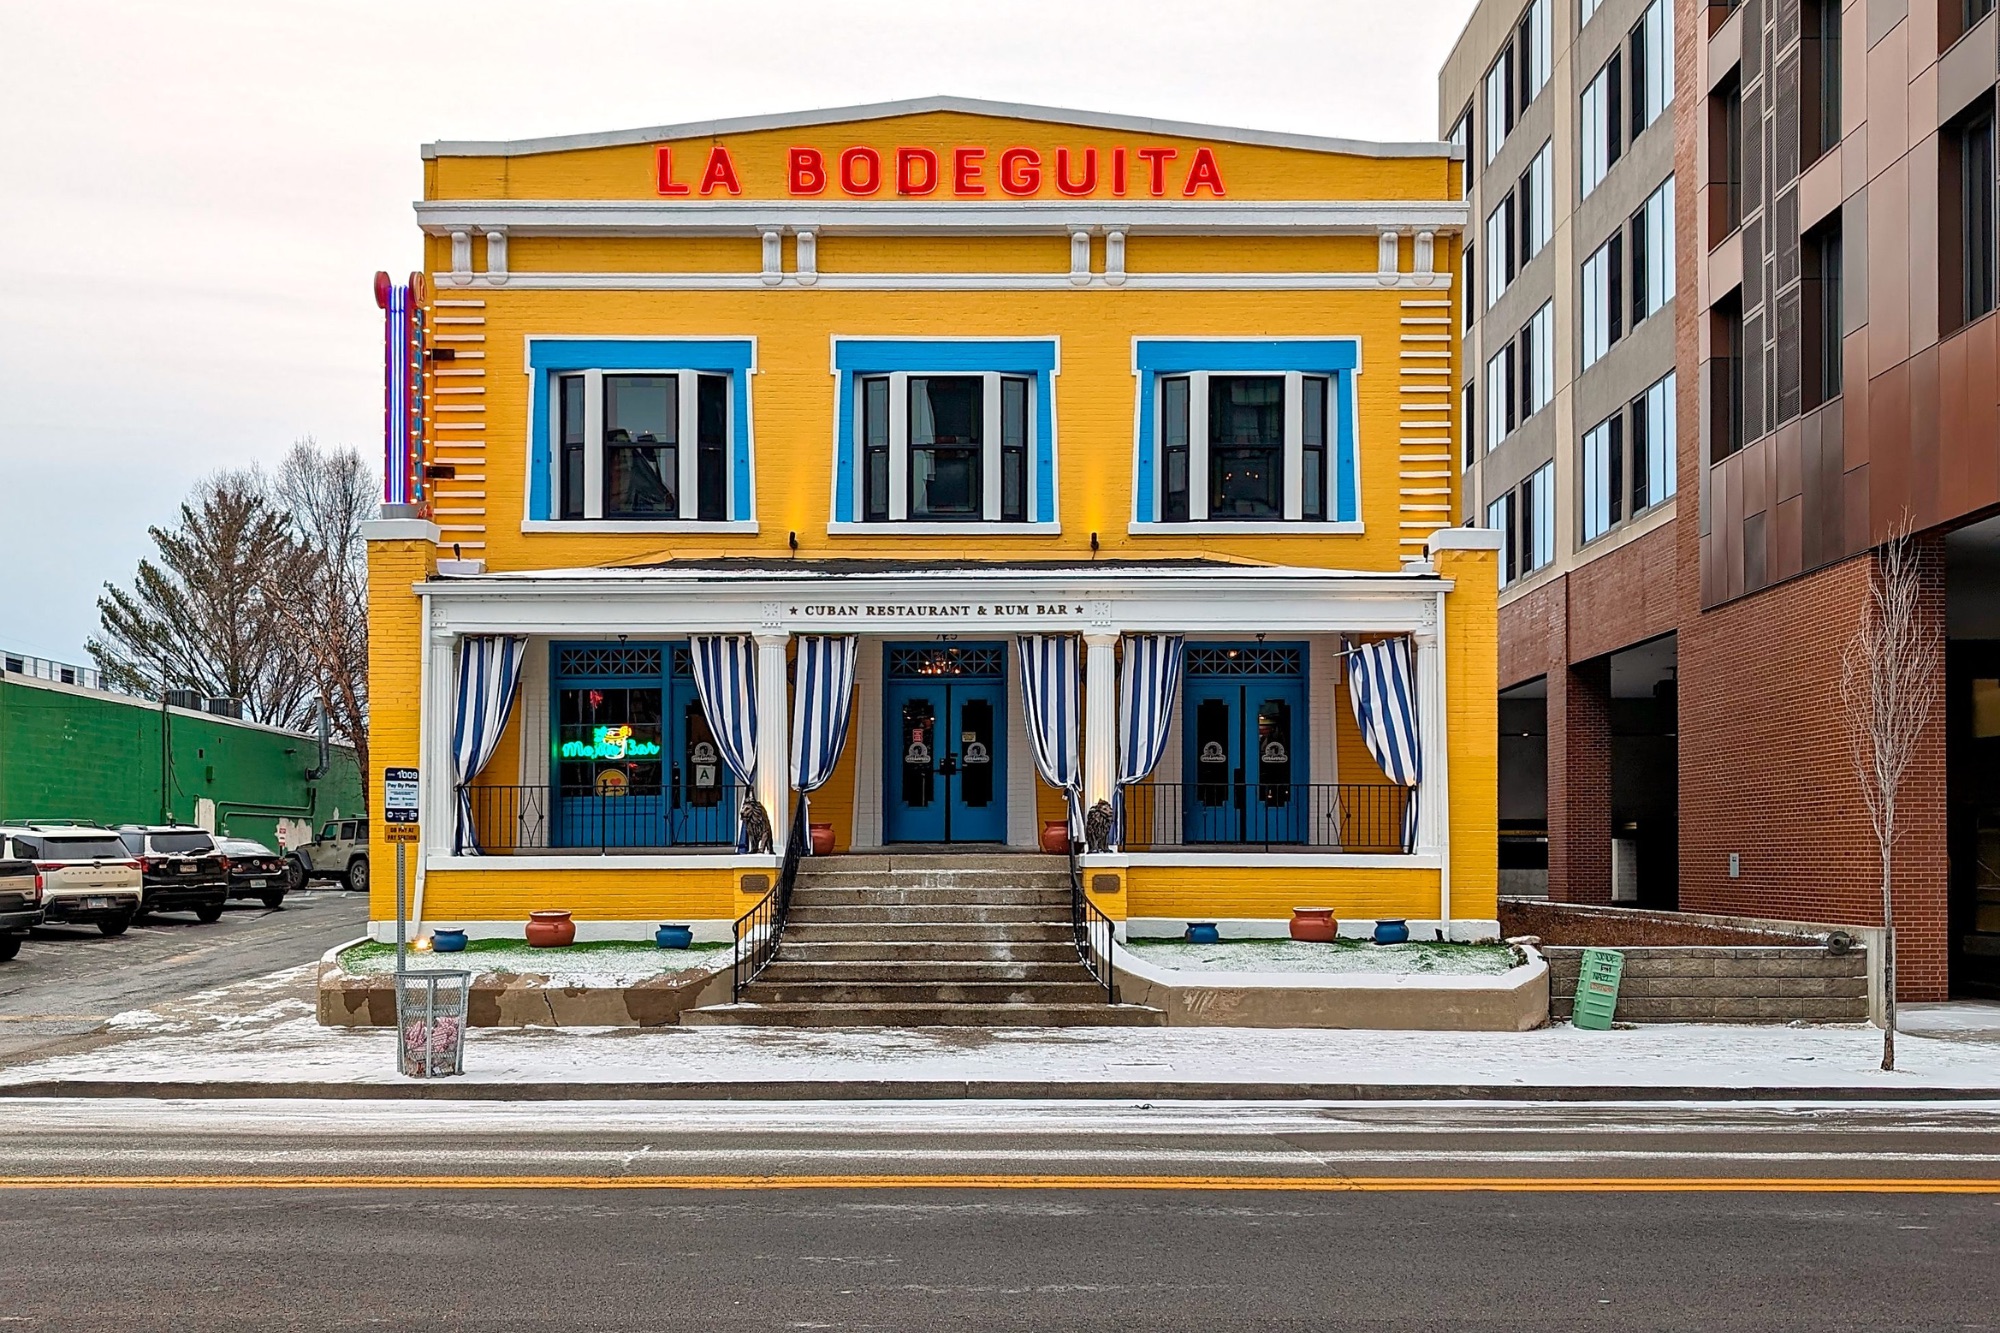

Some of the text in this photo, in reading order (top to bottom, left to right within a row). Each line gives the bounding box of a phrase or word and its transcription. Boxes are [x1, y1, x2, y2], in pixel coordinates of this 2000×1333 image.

[656, 145, 1226, 196] LA BODEGUITA
[804, 604, 1068, 616] CUBAN RESTAURANT & RUM BAR
[699, 768, 709, 780] A
